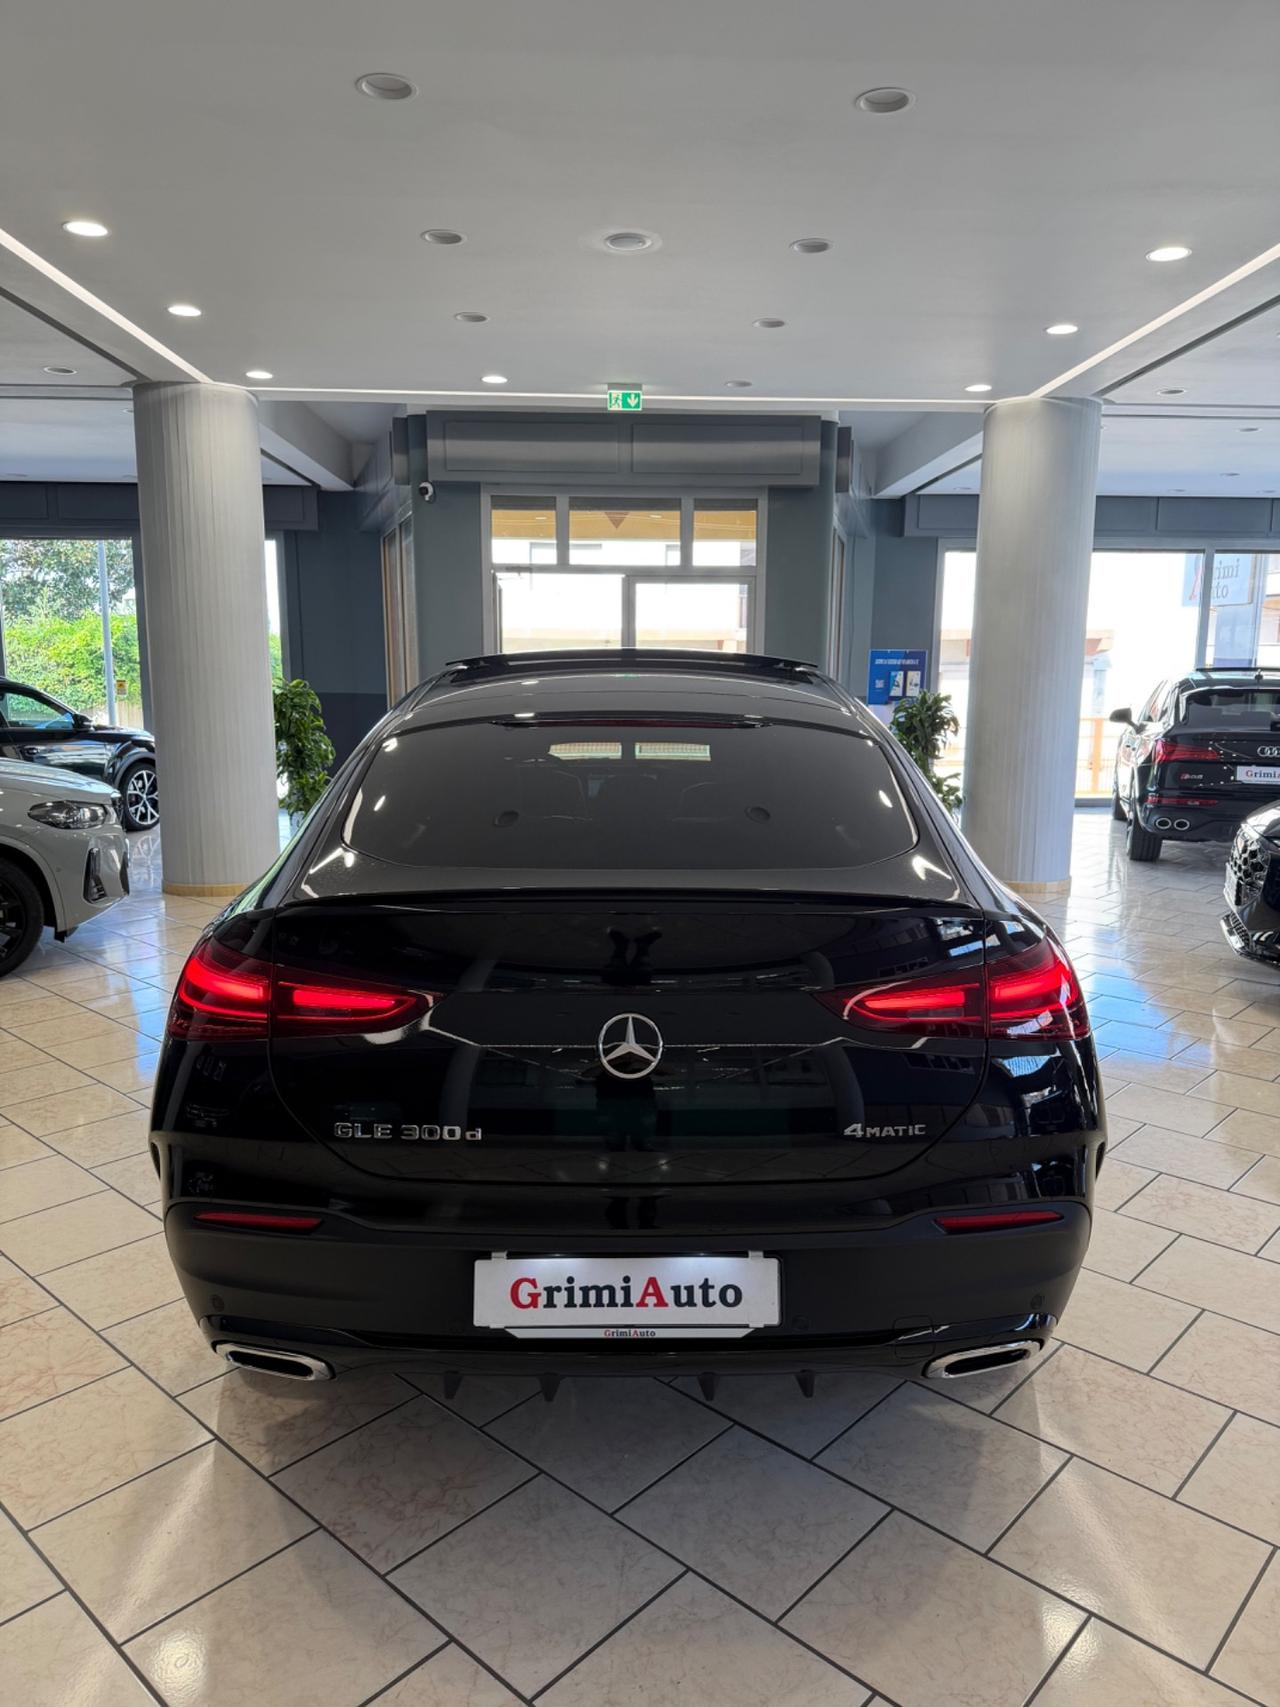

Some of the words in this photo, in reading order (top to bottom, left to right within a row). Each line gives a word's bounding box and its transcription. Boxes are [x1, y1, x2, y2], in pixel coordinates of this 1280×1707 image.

[334, 1122, 393, 1139] GLE
[400, 1124, 482, 1141] 300d
[843, 1122, 926, 1138] 4MATIC
[509, 1275, 743, 1309] GrimiAuto
[603, 1329, 656, 1337] GrimiAuto
